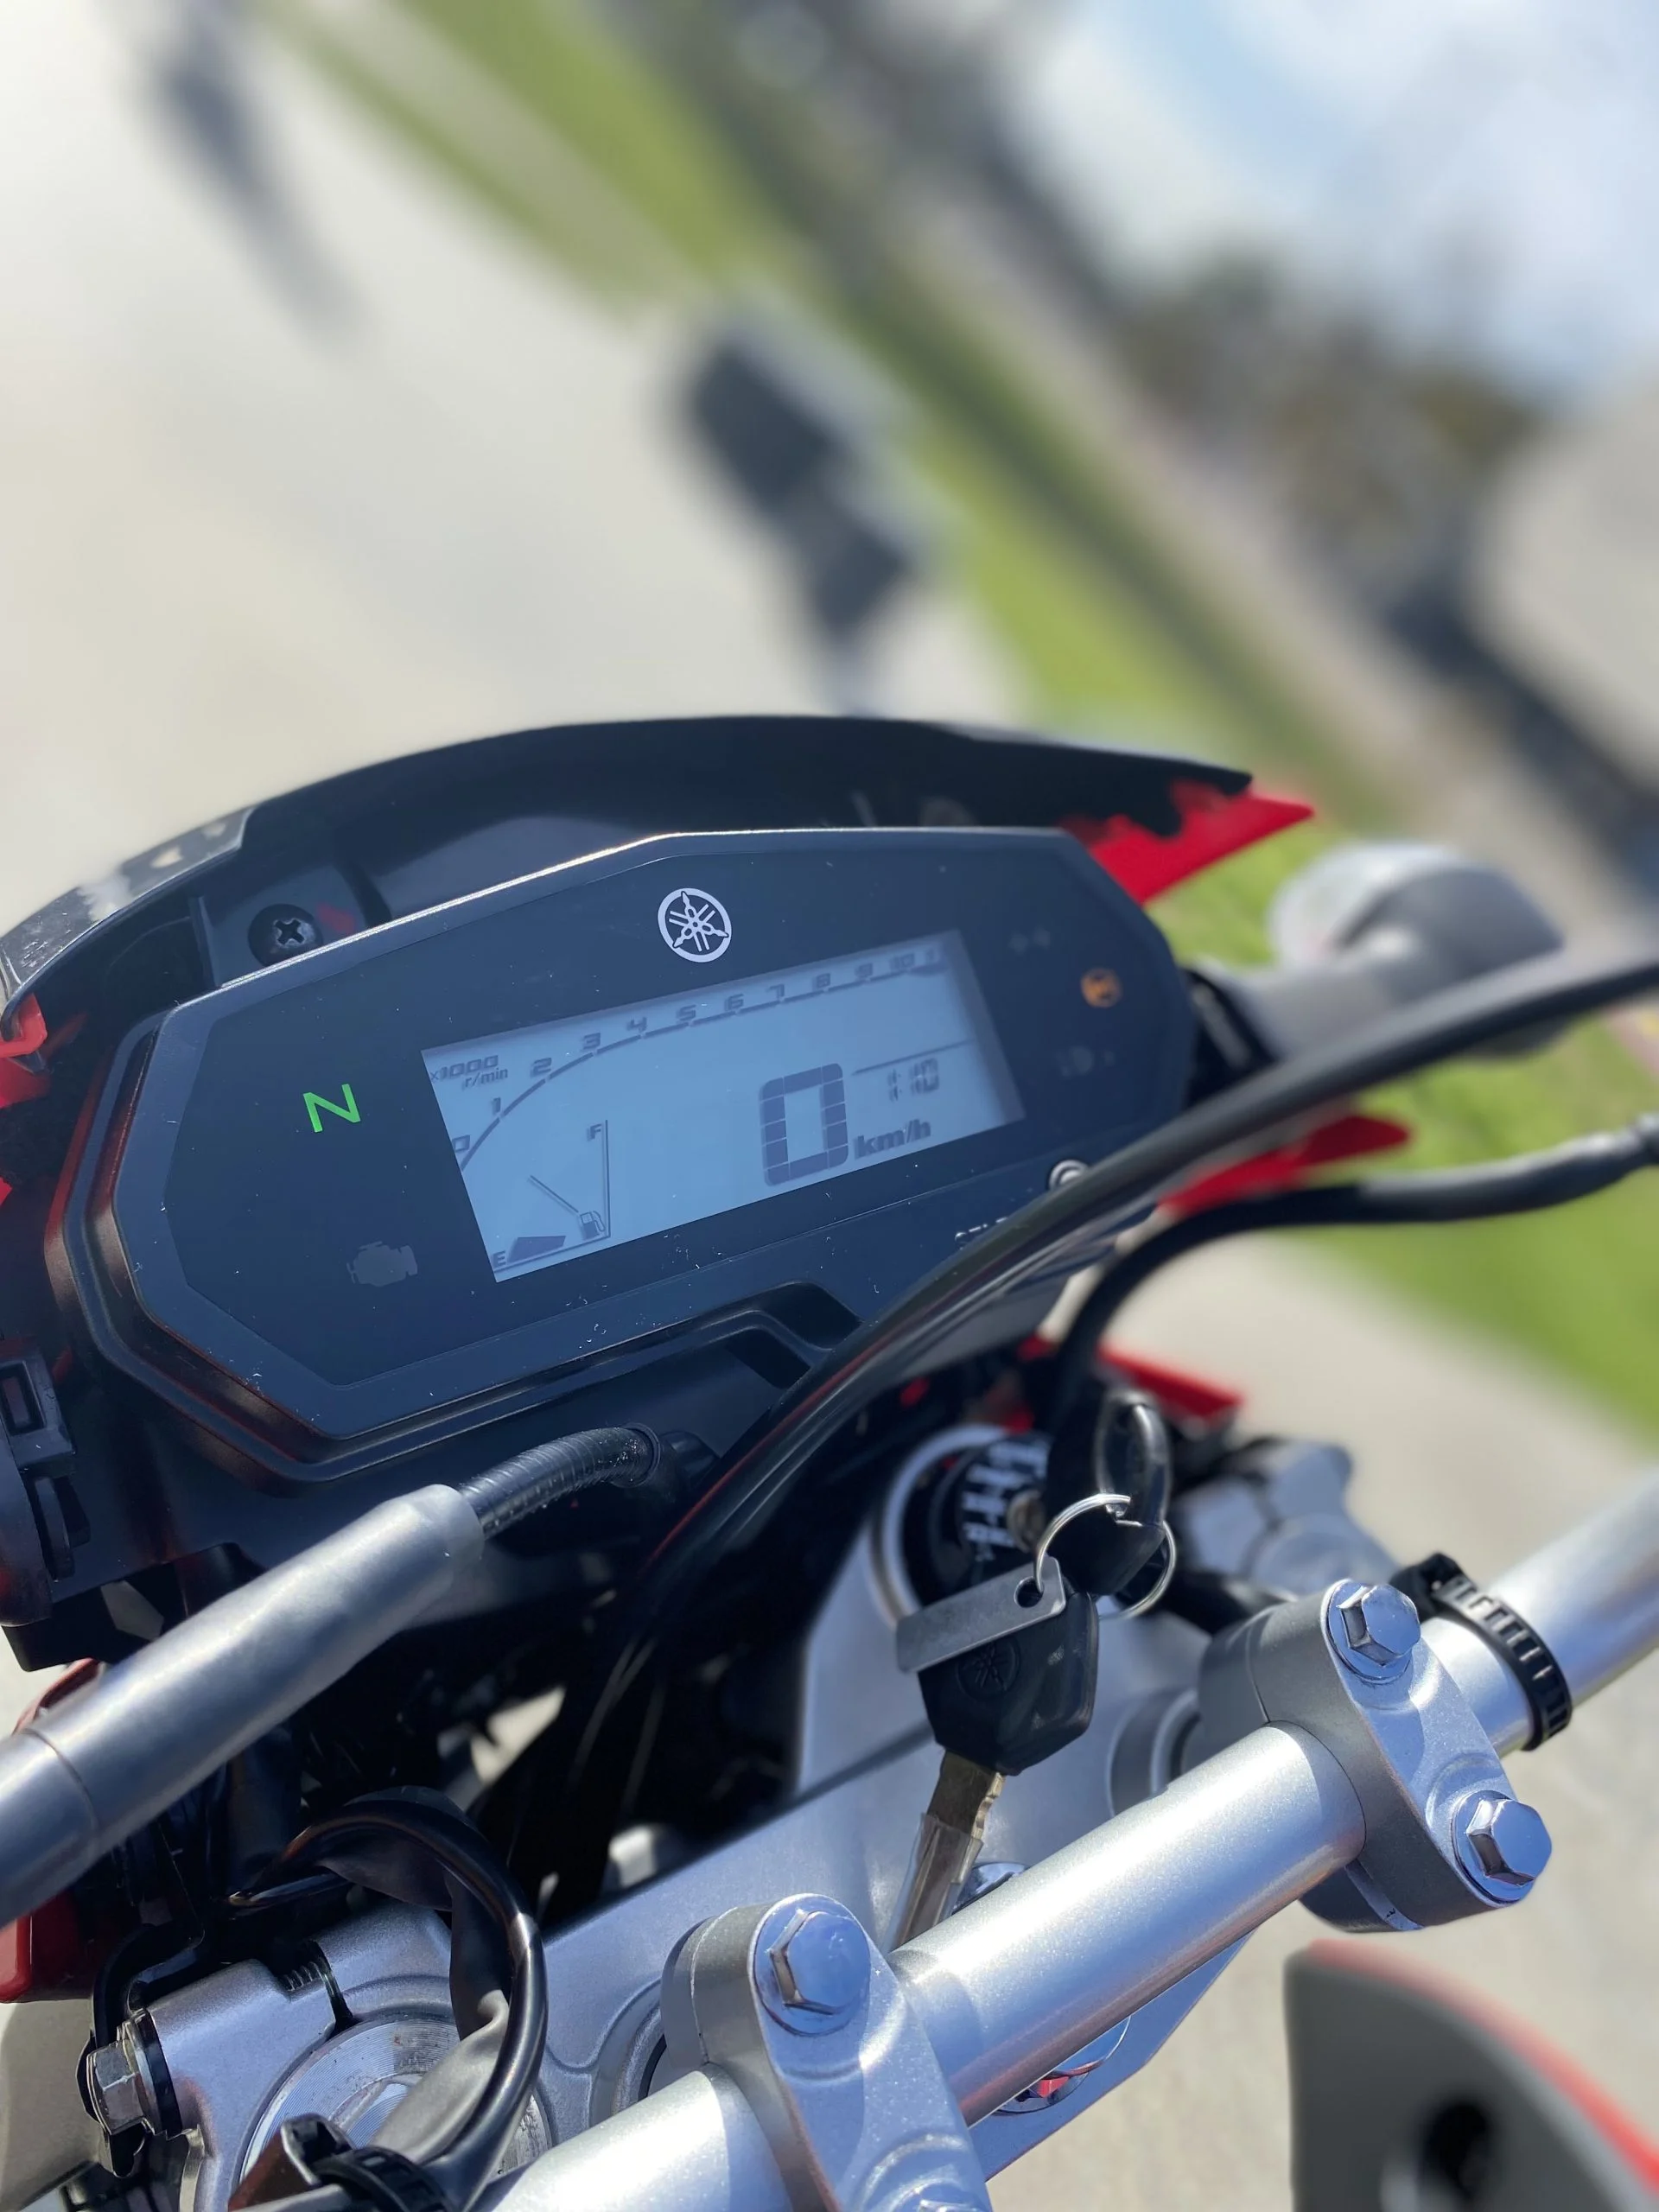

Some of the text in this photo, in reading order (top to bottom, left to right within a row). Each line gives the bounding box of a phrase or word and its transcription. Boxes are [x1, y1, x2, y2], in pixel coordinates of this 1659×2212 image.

[491, 1096, 501, 1115] 1
[531, 1058, 552, 1076] 2
[582, 1033, 601, 1050] 3
[628, 1017, 647, 1033] 4
[677, 1006, 696, 1021] 5
[725, 995, 744, 1010] 6
[767, 983, 785, 1001] 7
[813, 973, 830, 990] 8
[464, 1068, 508, 1088] r/min
[303, 1083, 360, 1133] N
[760, 1063, 849, 1186] 0
[588, 1123, 601, 1140] F
[854, 1119, 931, 1159] km/h
[493, 1250, 506, 1267] E
